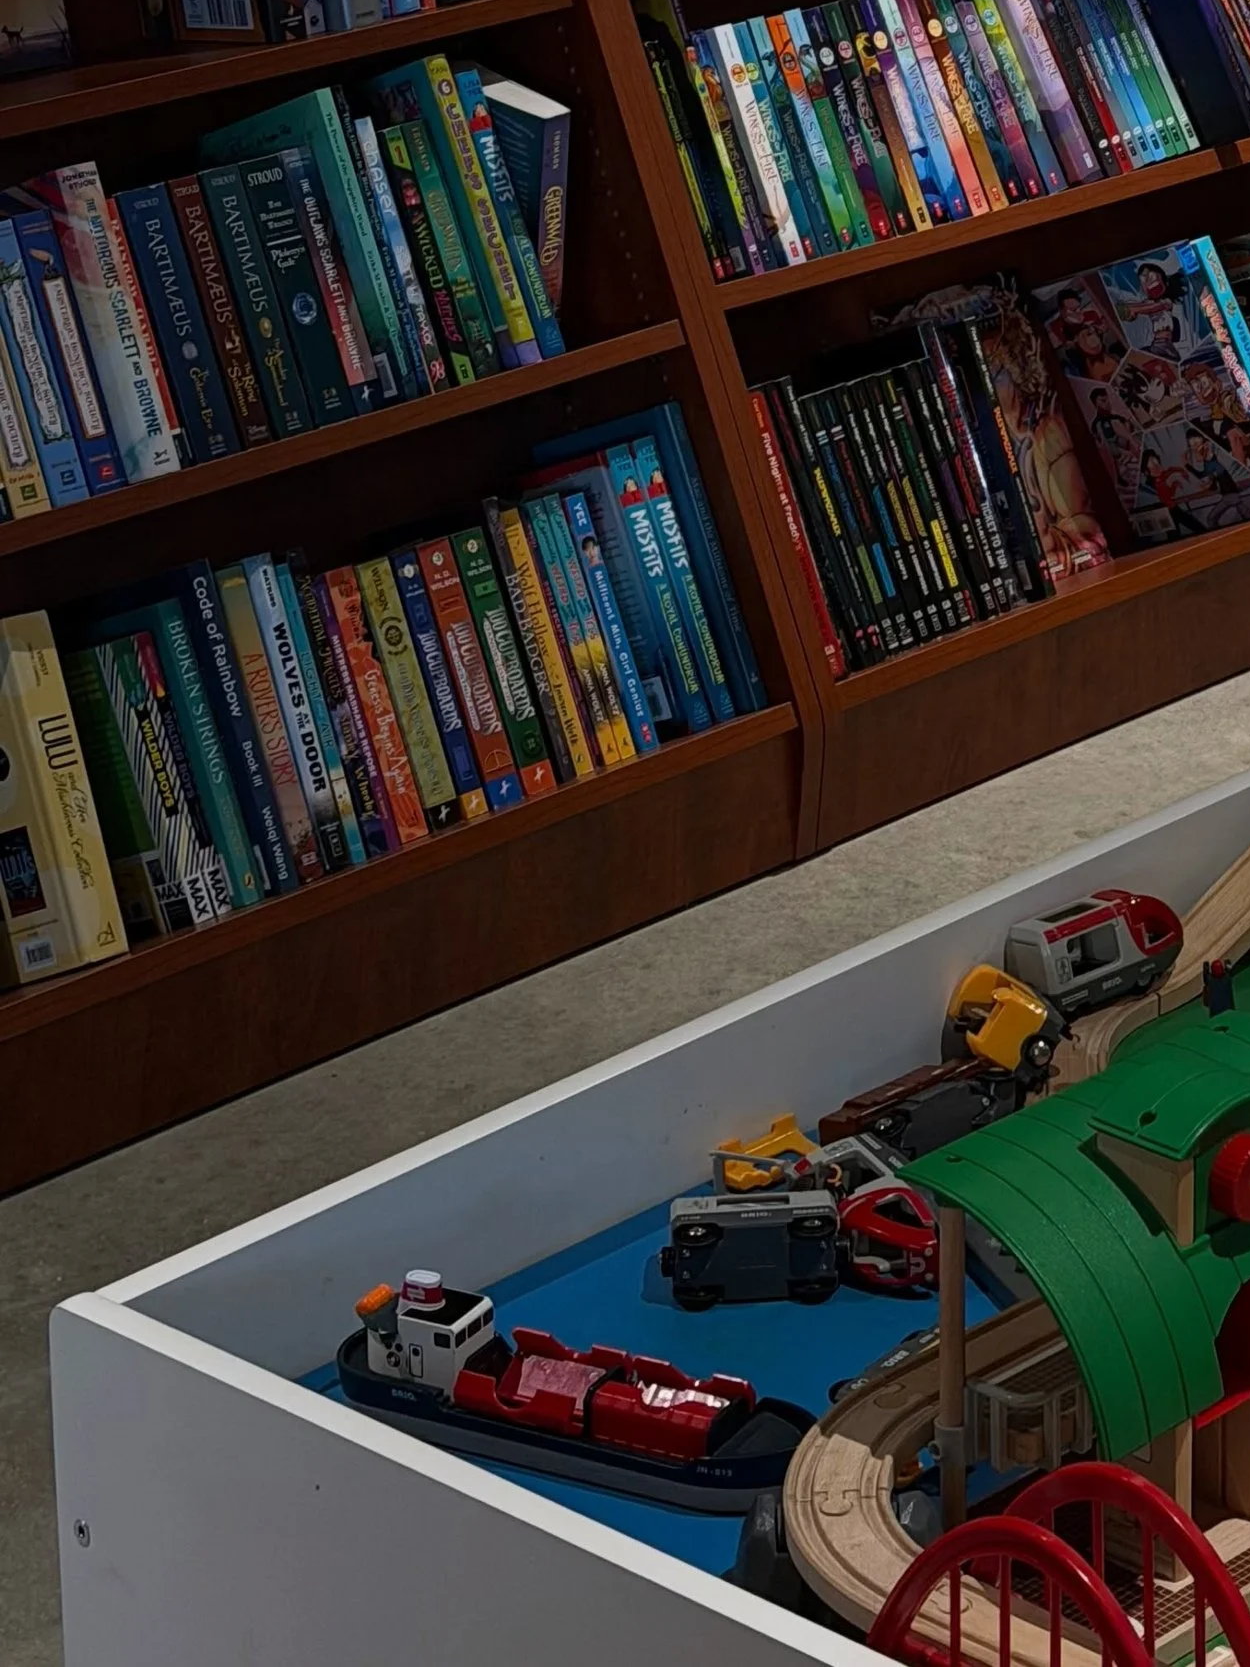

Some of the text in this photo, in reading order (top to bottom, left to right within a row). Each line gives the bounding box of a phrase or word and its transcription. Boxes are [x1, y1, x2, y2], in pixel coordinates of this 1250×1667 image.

[247, 170, 284, 188] STROUD
[303, 196, 328, 248] OUTLAWS
[319, 247, 344, 302] SCARLETT
[341, 317, 364, 371] BROWNE
[108, 291, 140, 359] SCARLETT
[134, 378, 163, 438] BROWNE
[573, 501, 588, 527] YEE
[628, 509, 664, 577] MISFITS
[655, 500, 690, 569] MISFITS
[192, 576, 214, 621] Code
[369, 566, 389, 613] WILSON
[205, 621, 218, 643] of
[506, 573, 551, 697] BAD BADGER
[211, 643, 244, 718] Rainbow
[271, 622, 306, 708] WOLVES
[167, 618, 225, 785] BROKEN STRINGS
[626, 677, 645, 717] Genius
[37, 713, 79, 771] LULU
[140, 717, 175, 810] WILDER BOYS
[241, 740, 261, 774] Book
[300, 731, 327, 793] DOOR
[186, 877, 212, 920] MAX
[207, 869, 231, 910] MAX
